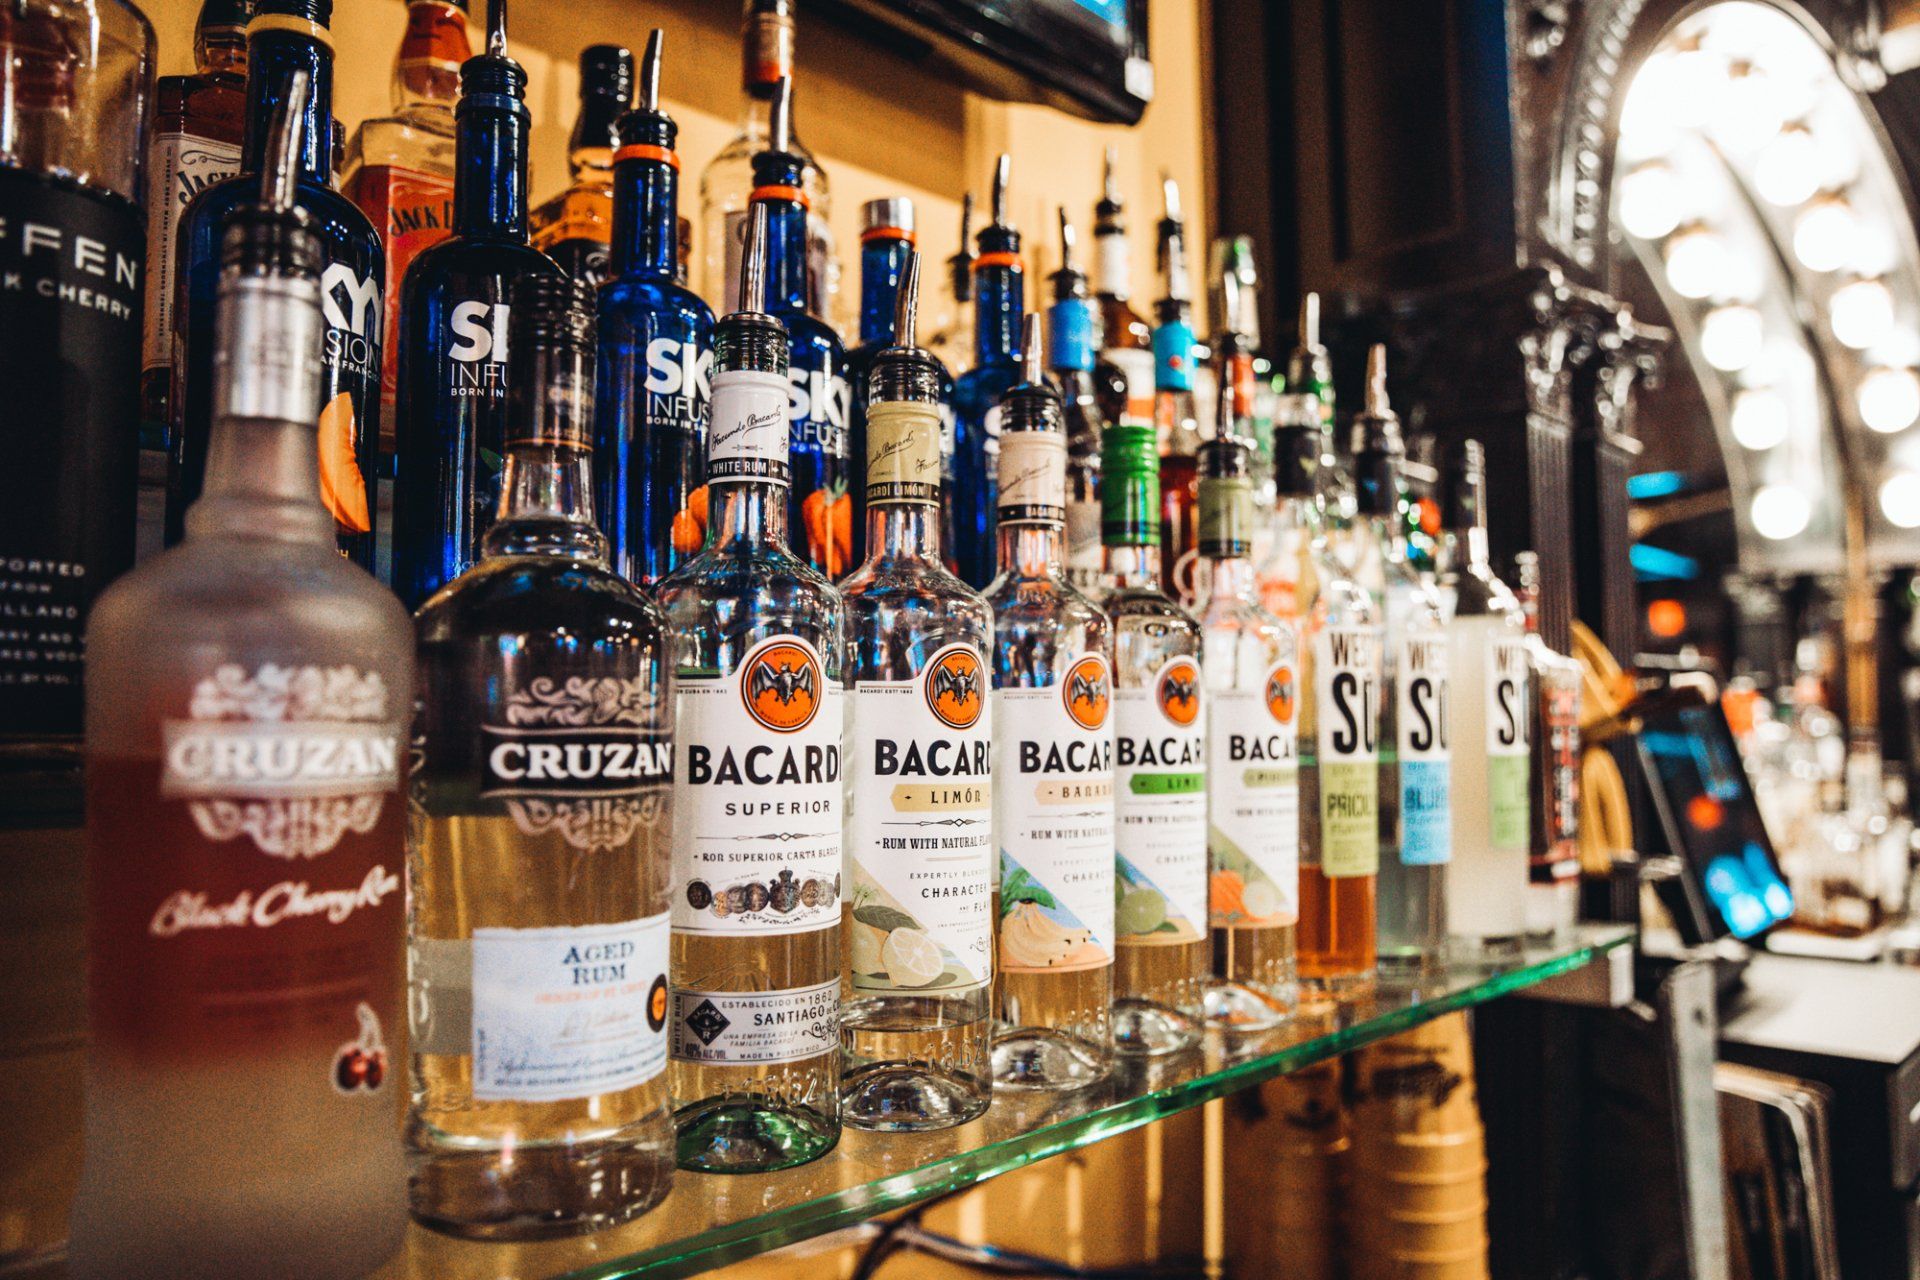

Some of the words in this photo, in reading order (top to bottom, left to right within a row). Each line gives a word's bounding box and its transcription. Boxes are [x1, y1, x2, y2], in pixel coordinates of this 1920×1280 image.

[388, 205, 438, 238] JACK
[36, 278, 131, 320] CHERRY
[450, 387, 485, 397] BORN
[490, 388, 504, 398] IN
[646, 416, 676, 427] BORN
[712, 460, 741, 474] WHITE
[744, 460, 767, 473] RUM
[167, 734, 398, 782] CRUZAN
[488, 741, 672, 780] CRUZAN
[930, 788, 982, 804] LIMÓN
[725, 800, 831, 817] SUPERIOR
[882, 837, 907, 850] RUM
[909, 837, 939, 850] WITH
[941, 834, 978, 849] NATURAL
[1030, 830, 1053, 840] RUM
[1055, 829, 1079, 839] WITH
[728, 850, 784, 863] SUPERIOR
[786, 849, 816, 861] CARTA
[909, 872, 959, 880] EXPERTLY
[562, 941, 636, 965] AGED
[572, 963, 626, 985] RUM
[673, 995, 682, 1014] RUM
[721, 998, 792, 1009] ESTABLECIDO
[794, 997, 806, 1005] EN
[808, 990, 833, 1006] 1862
[753, 1004, 825, 1027] SANTIAGO
[673, 1019, 682, 1055] WHITE
[723, 1033, 739, 1041] UNA
[741, 1031, 777, 1040] EMPRESA
[730, 1039, 761, 1047] FAMILIA
[739, 1052, 762, 1060] MADE
[765, 1051, 774, 1059] IN
[805, 1043, 821, 1053] RICO
